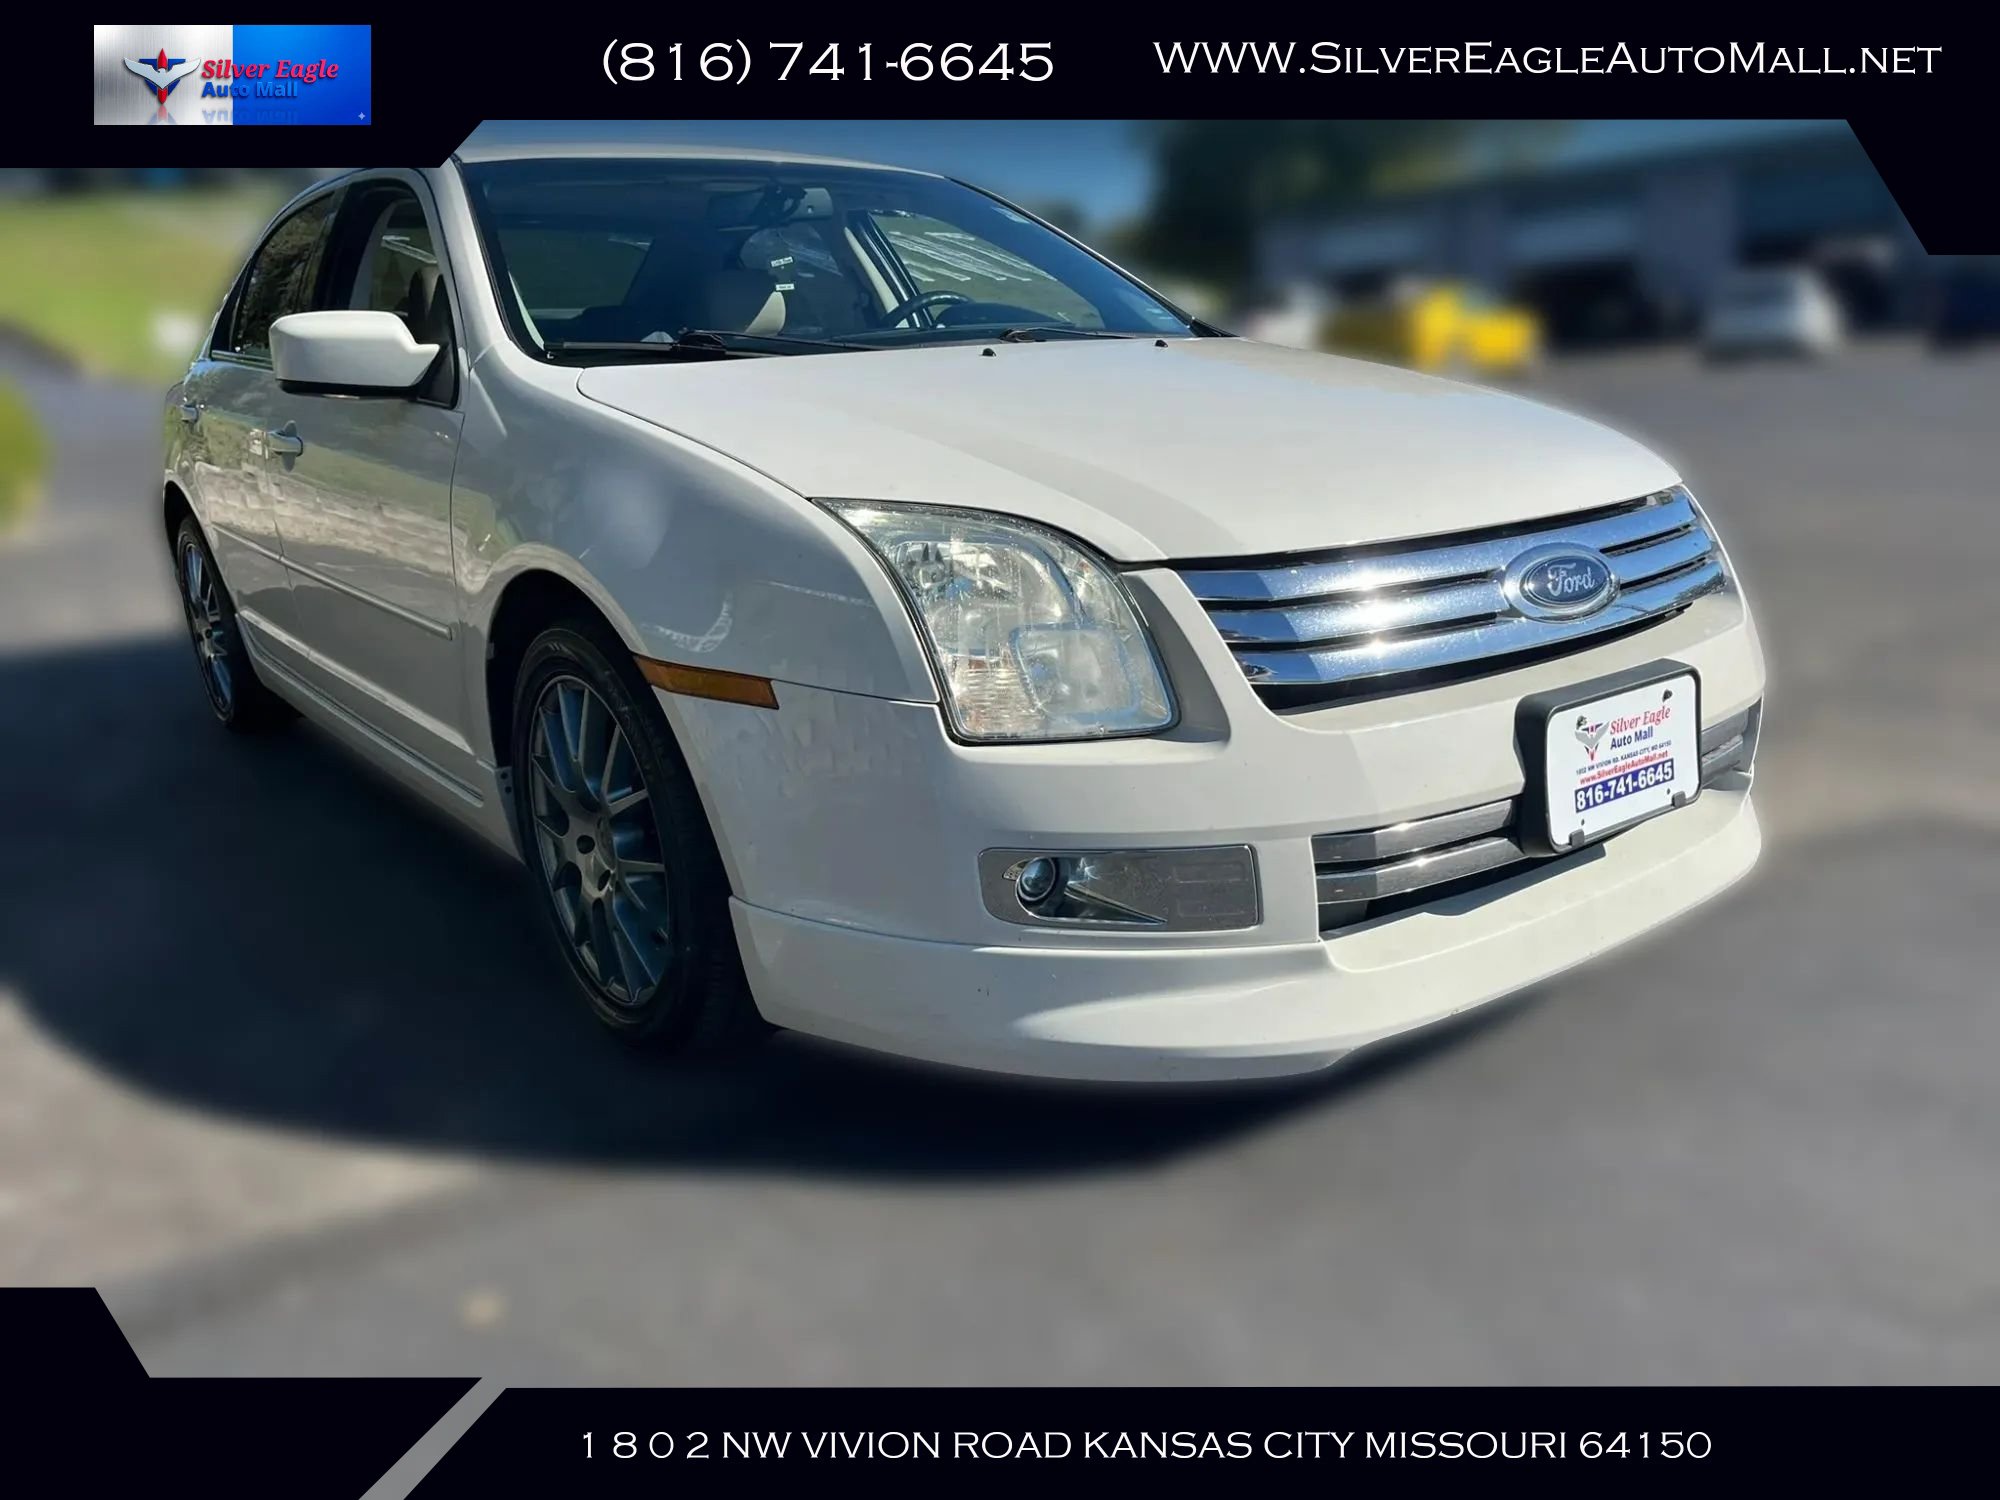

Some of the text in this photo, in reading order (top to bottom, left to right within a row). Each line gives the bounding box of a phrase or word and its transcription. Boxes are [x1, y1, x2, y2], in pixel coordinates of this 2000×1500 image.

[1547, 562, 1596, 596] Ford
[1610, 706, 1671, 735] Silver Eagle
[1610, 726, 1653, 750] Auto Mall
[1580, 750, 1669, 785] www.SilverEagleAutoMall.net
[1621, 751, 1638, 760] KANSAS
[1576, 762, 1673, 810] 816-741-6645
